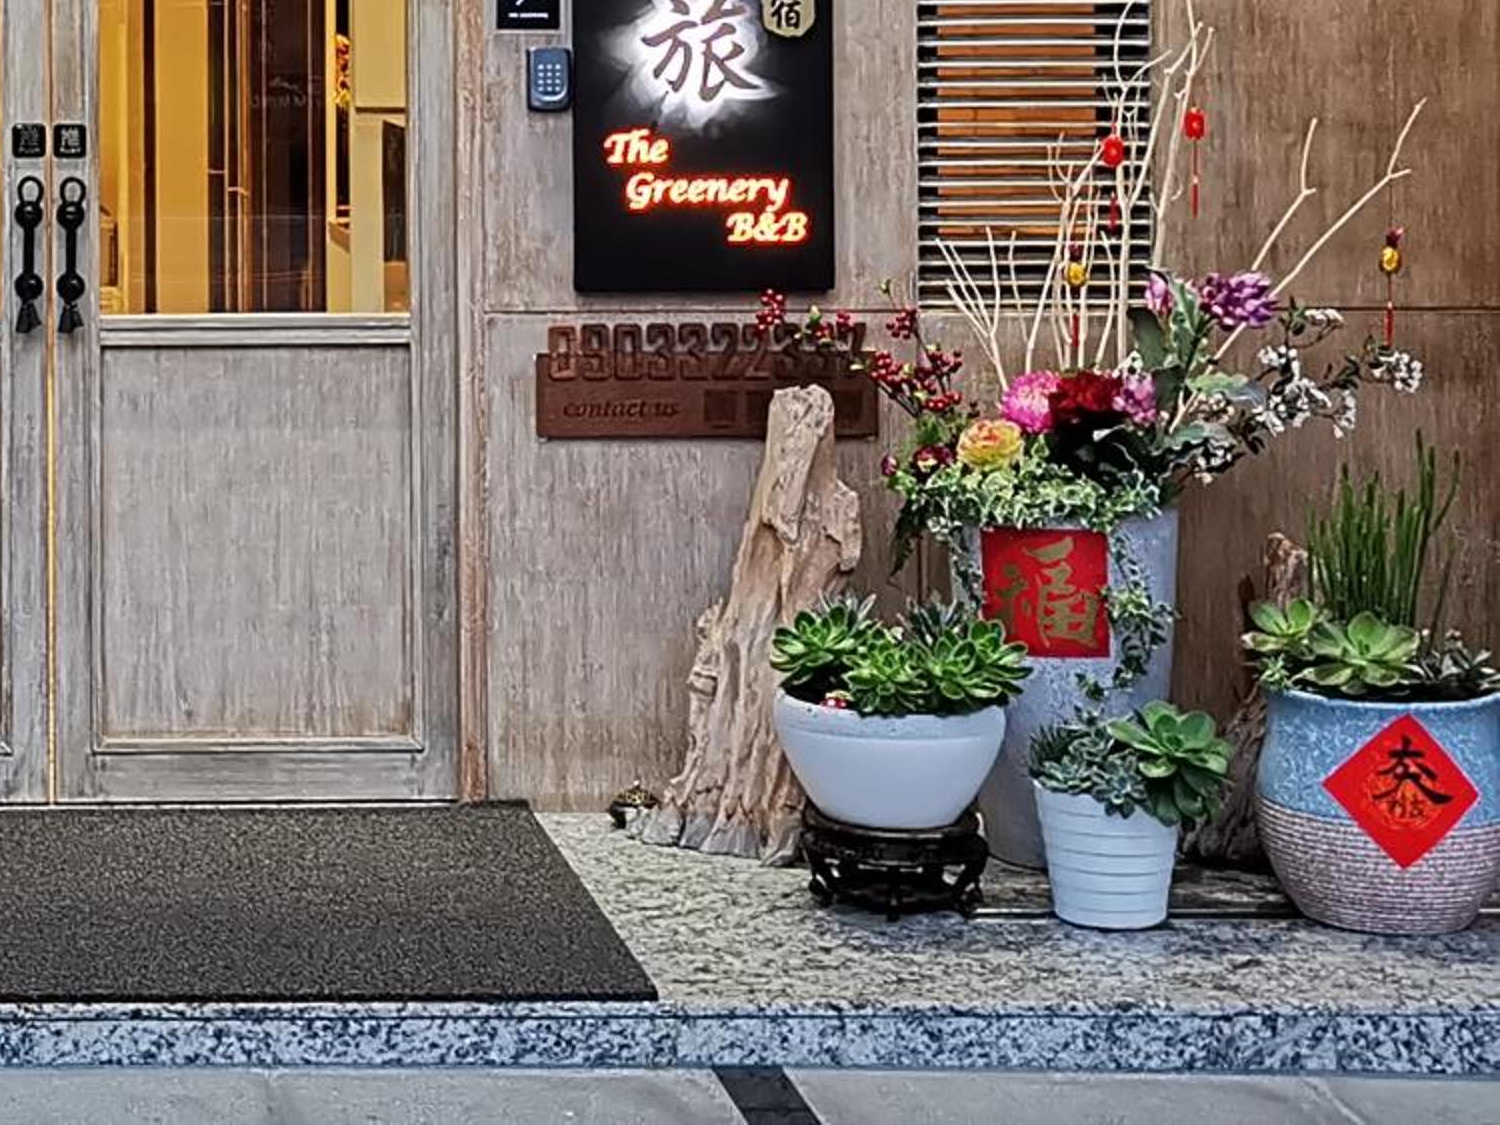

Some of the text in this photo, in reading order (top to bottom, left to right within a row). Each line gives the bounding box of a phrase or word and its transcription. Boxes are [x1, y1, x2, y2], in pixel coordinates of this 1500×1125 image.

[603, 127, 670, 164] The
[625, 171, 790, 213] Greenery
[725, 211, 809, 243] B&B
[563, 398, 680, 418] contact us
[992, 535, 1101, 649] 福
